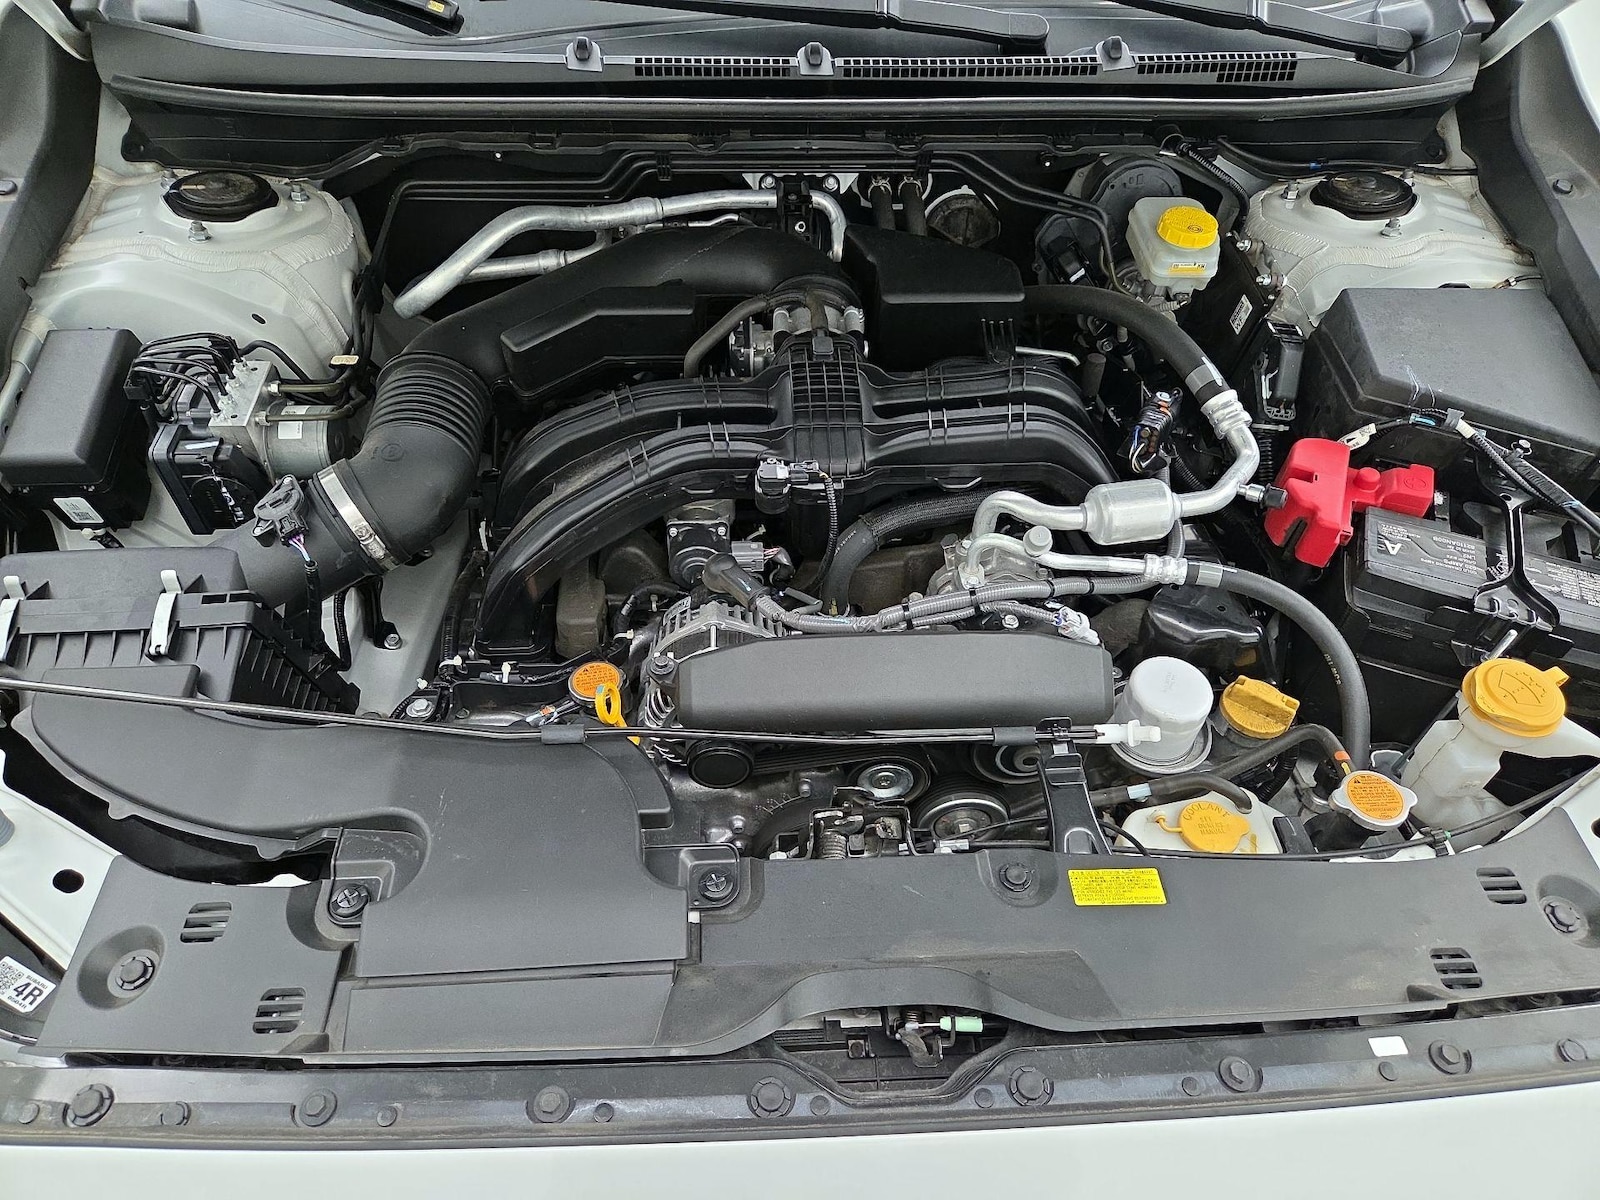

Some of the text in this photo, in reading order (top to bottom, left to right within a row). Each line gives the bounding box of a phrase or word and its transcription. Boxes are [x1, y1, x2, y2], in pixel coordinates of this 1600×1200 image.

[1182, 803, 1230, 821] COOLANT
[26, 975, 48, 990] SUBARU
[13, 982, 44, 1006] 4R
